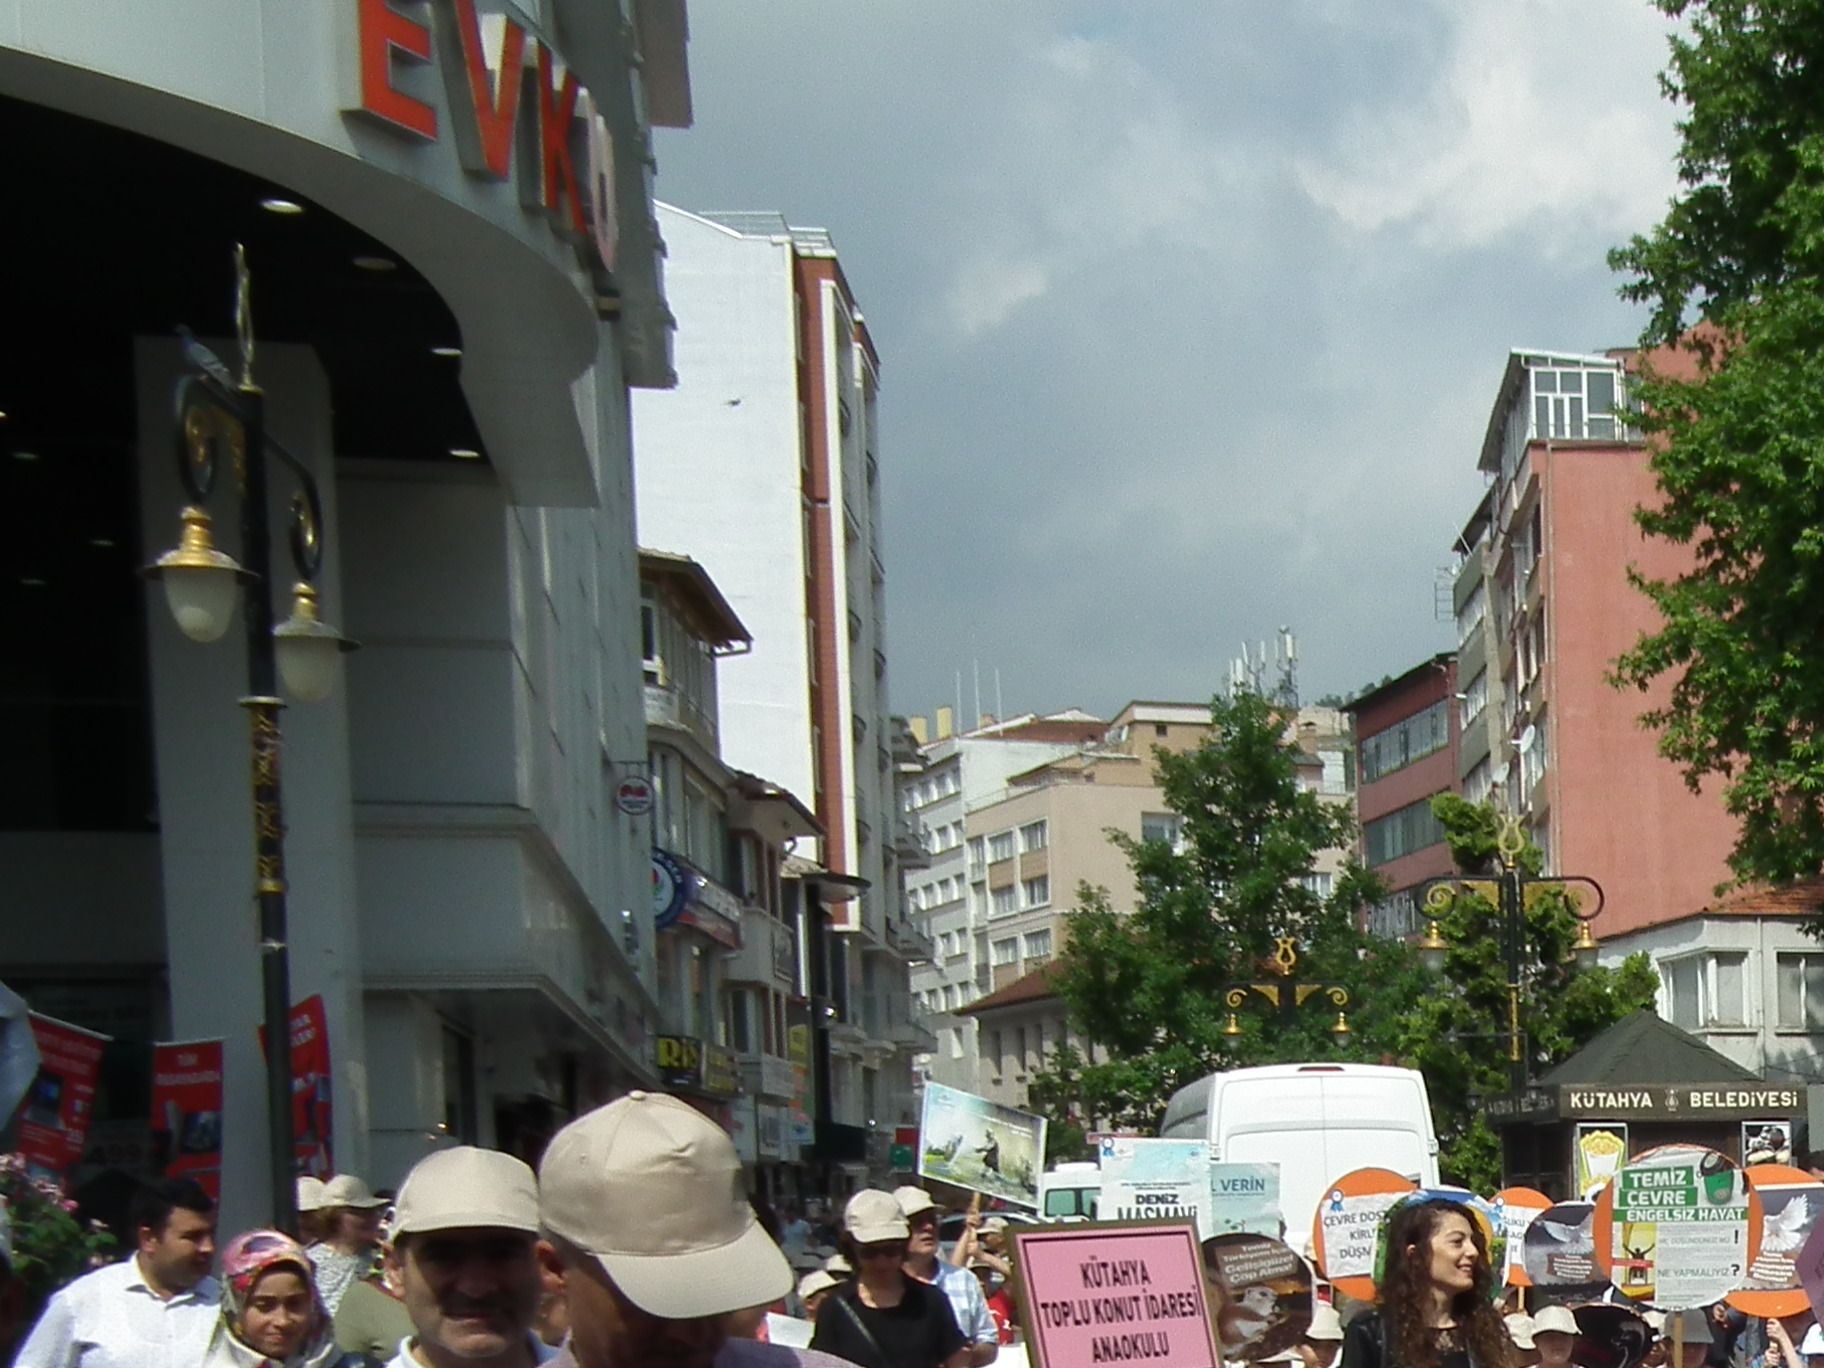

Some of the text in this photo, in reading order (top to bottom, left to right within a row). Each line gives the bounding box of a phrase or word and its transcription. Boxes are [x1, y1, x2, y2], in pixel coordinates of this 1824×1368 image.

[1570, 1092, 1653, 1108] KÜTAHYA
[1220, 1175, 1266, 1192] VERİN
[1629, 1167, 1687, 1188] TEMİZ
[1134, 1192, 1179, 1206] DENİZ
[1626, 1190, 1687, 1208] ÇEVRE
[1324, 1213, 1358, 1228] ÇEVRE
[1698, 1207, 1745, 1221] HAYAT
[1080, 1254, 1152, 1289] KÜTAHYA
[1041, 1284, 1202, 1329] TOPLU KONUT İDARESİ
[1091, 1331, 1171, 1364] ANAOKULU
